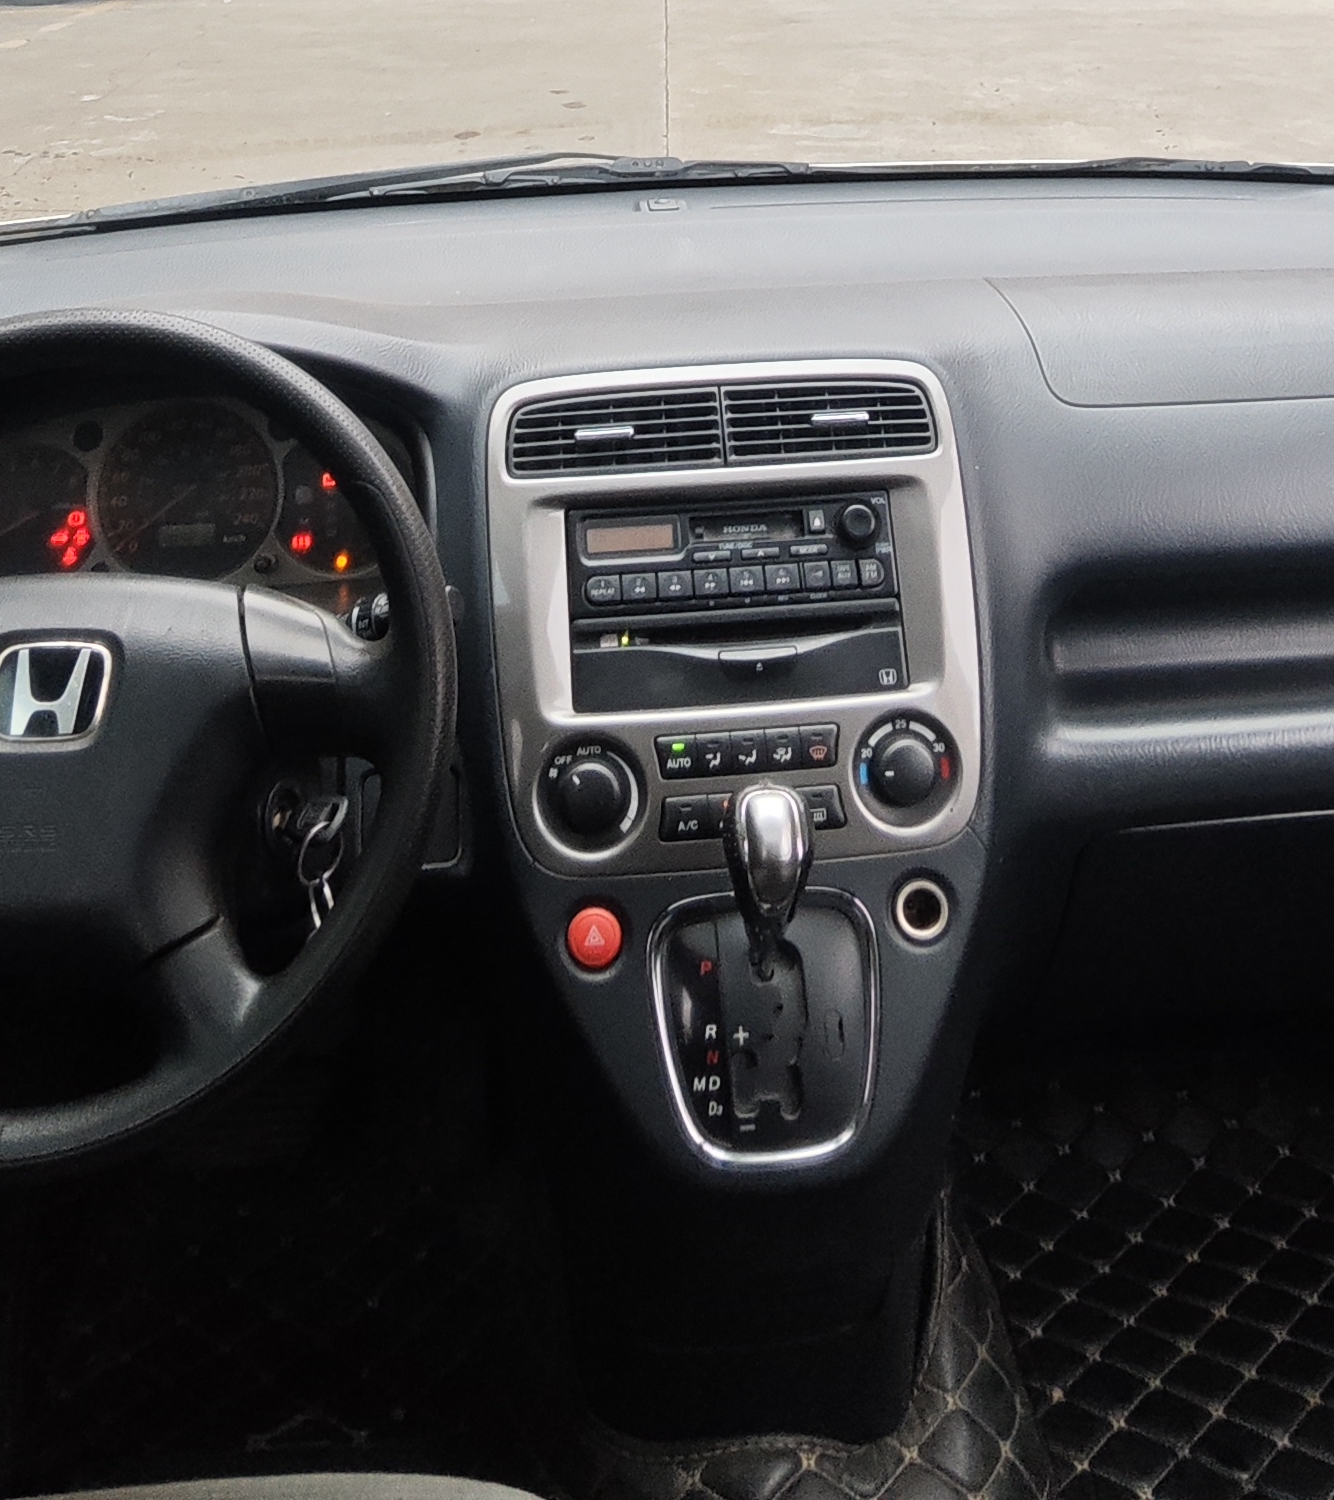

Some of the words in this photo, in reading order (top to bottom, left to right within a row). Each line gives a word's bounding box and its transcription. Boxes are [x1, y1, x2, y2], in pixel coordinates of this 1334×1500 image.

[722, 524, 768, 534] HONDA
[894, 719, 907, 729] 25
[576, 745, 602, 756] AUTO
[860, 747, 873, 758] 20
[932, 742, 945, 752] 30
[554, 754, 572, 765] OFF
[666, 757, 691, 769] AUTO
[677, 819, 699, 831] A/C
[700, 960, 712, 976] P
[704, 1024, 718, 1041] R
[706, 1050, 720, 1065] N
